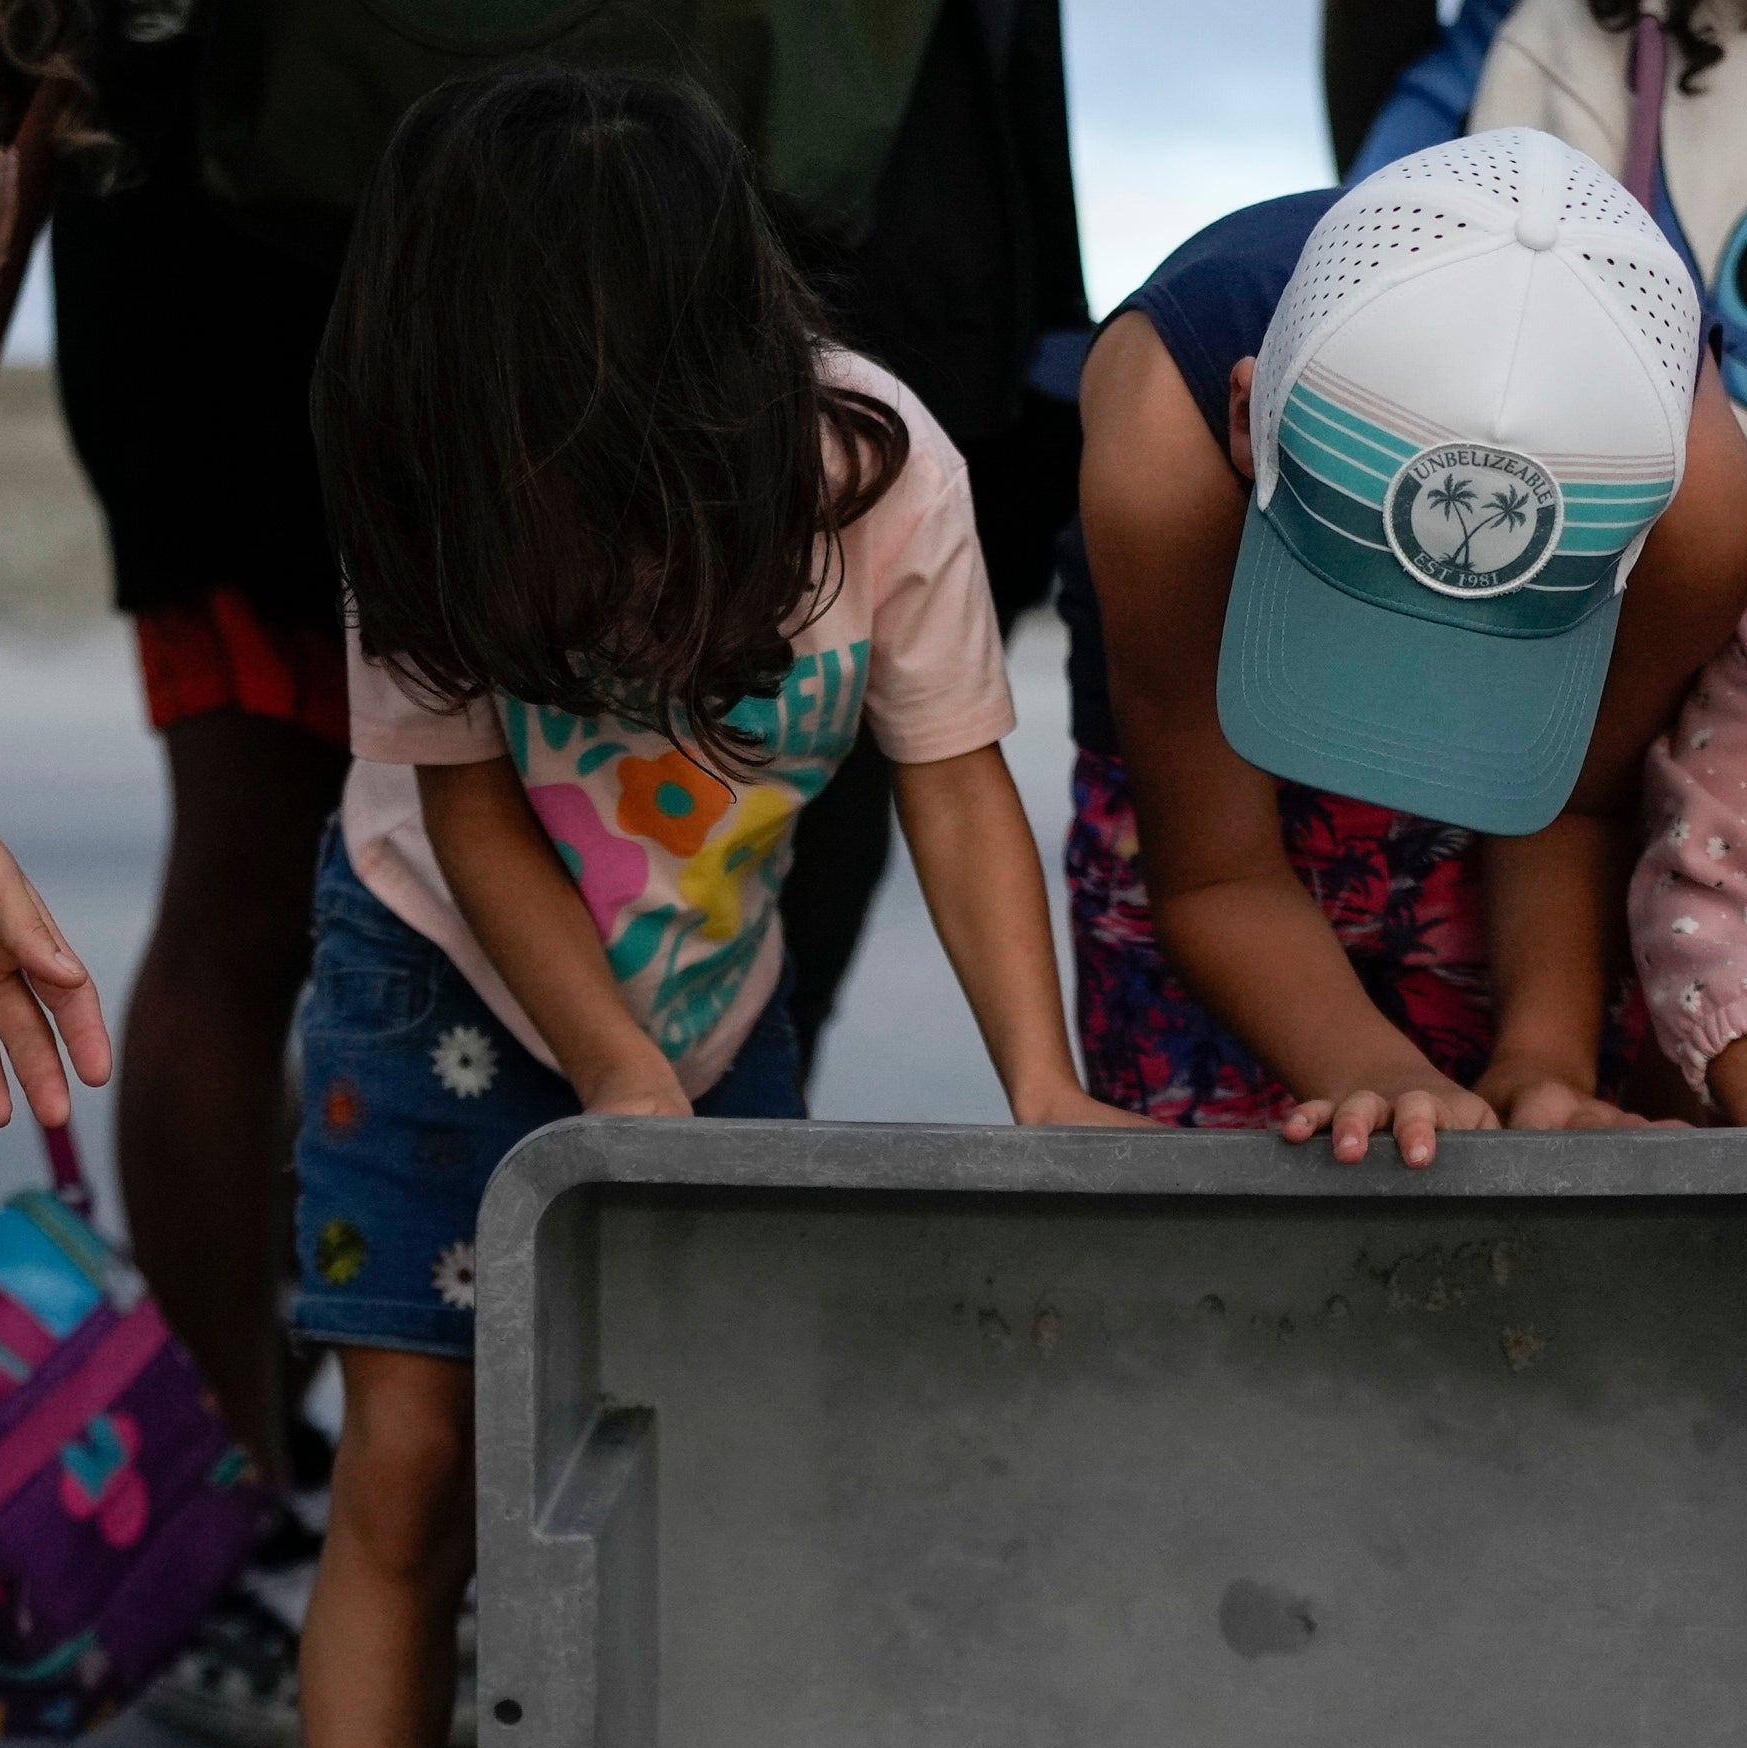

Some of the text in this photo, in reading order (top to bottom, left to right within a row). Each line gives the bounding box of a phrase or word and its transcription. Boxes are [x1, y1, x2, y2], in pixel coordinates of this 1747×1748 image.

[1413, 450, 1553, 505] UNBELIZEABLE
[1414, 552, 1499, 588] EST 1981
